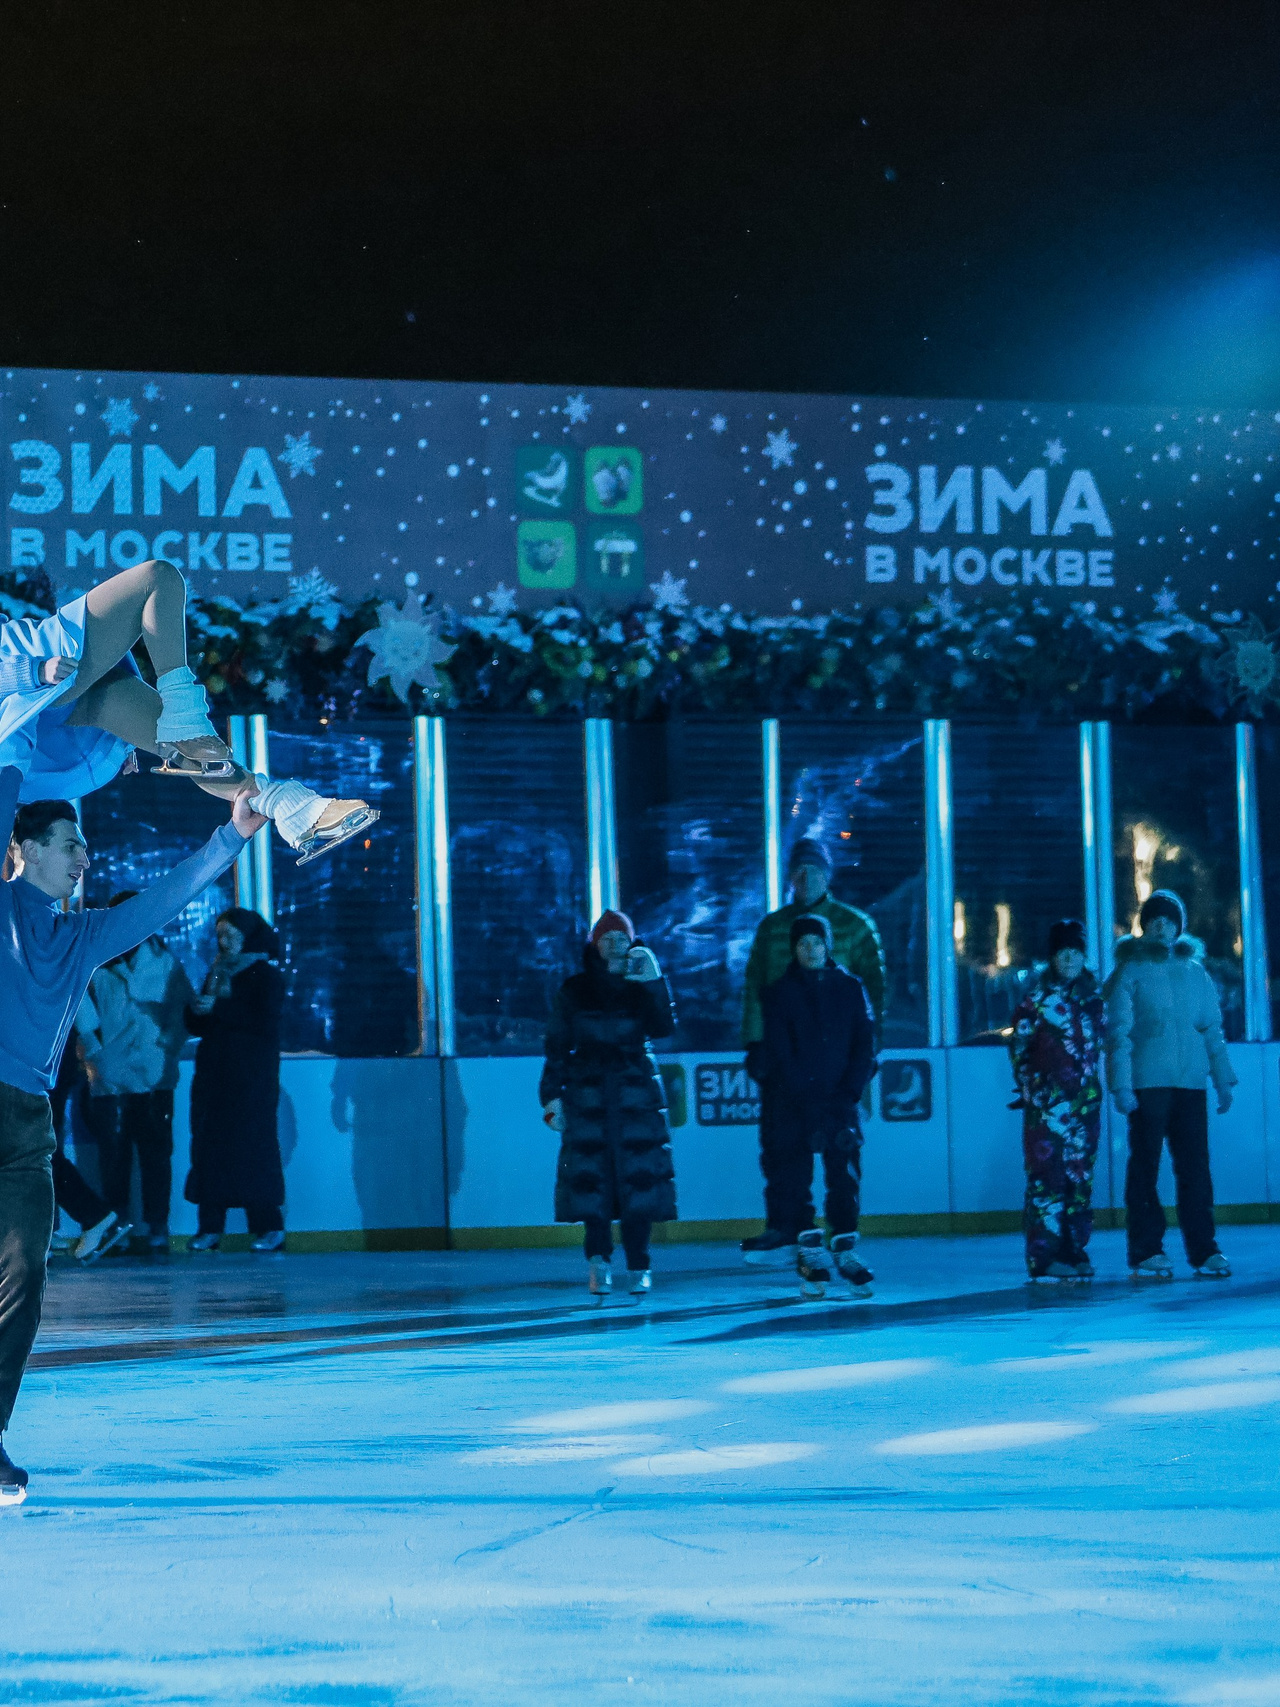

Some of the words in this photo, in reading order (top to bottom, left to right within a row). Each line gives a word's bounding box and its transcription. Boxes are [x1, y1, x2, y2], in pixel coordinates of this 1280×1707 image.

[9, 439, 292, 518] ЗИМА
[864, 462, 1114, 537] ЗИМА
[10, 527, 46, 566] В
[65, 529, 293, 572] МОСКВЕ
[865, 544, 898, 583] В
[913, 546, 1116, 587] МОСКВЕ
